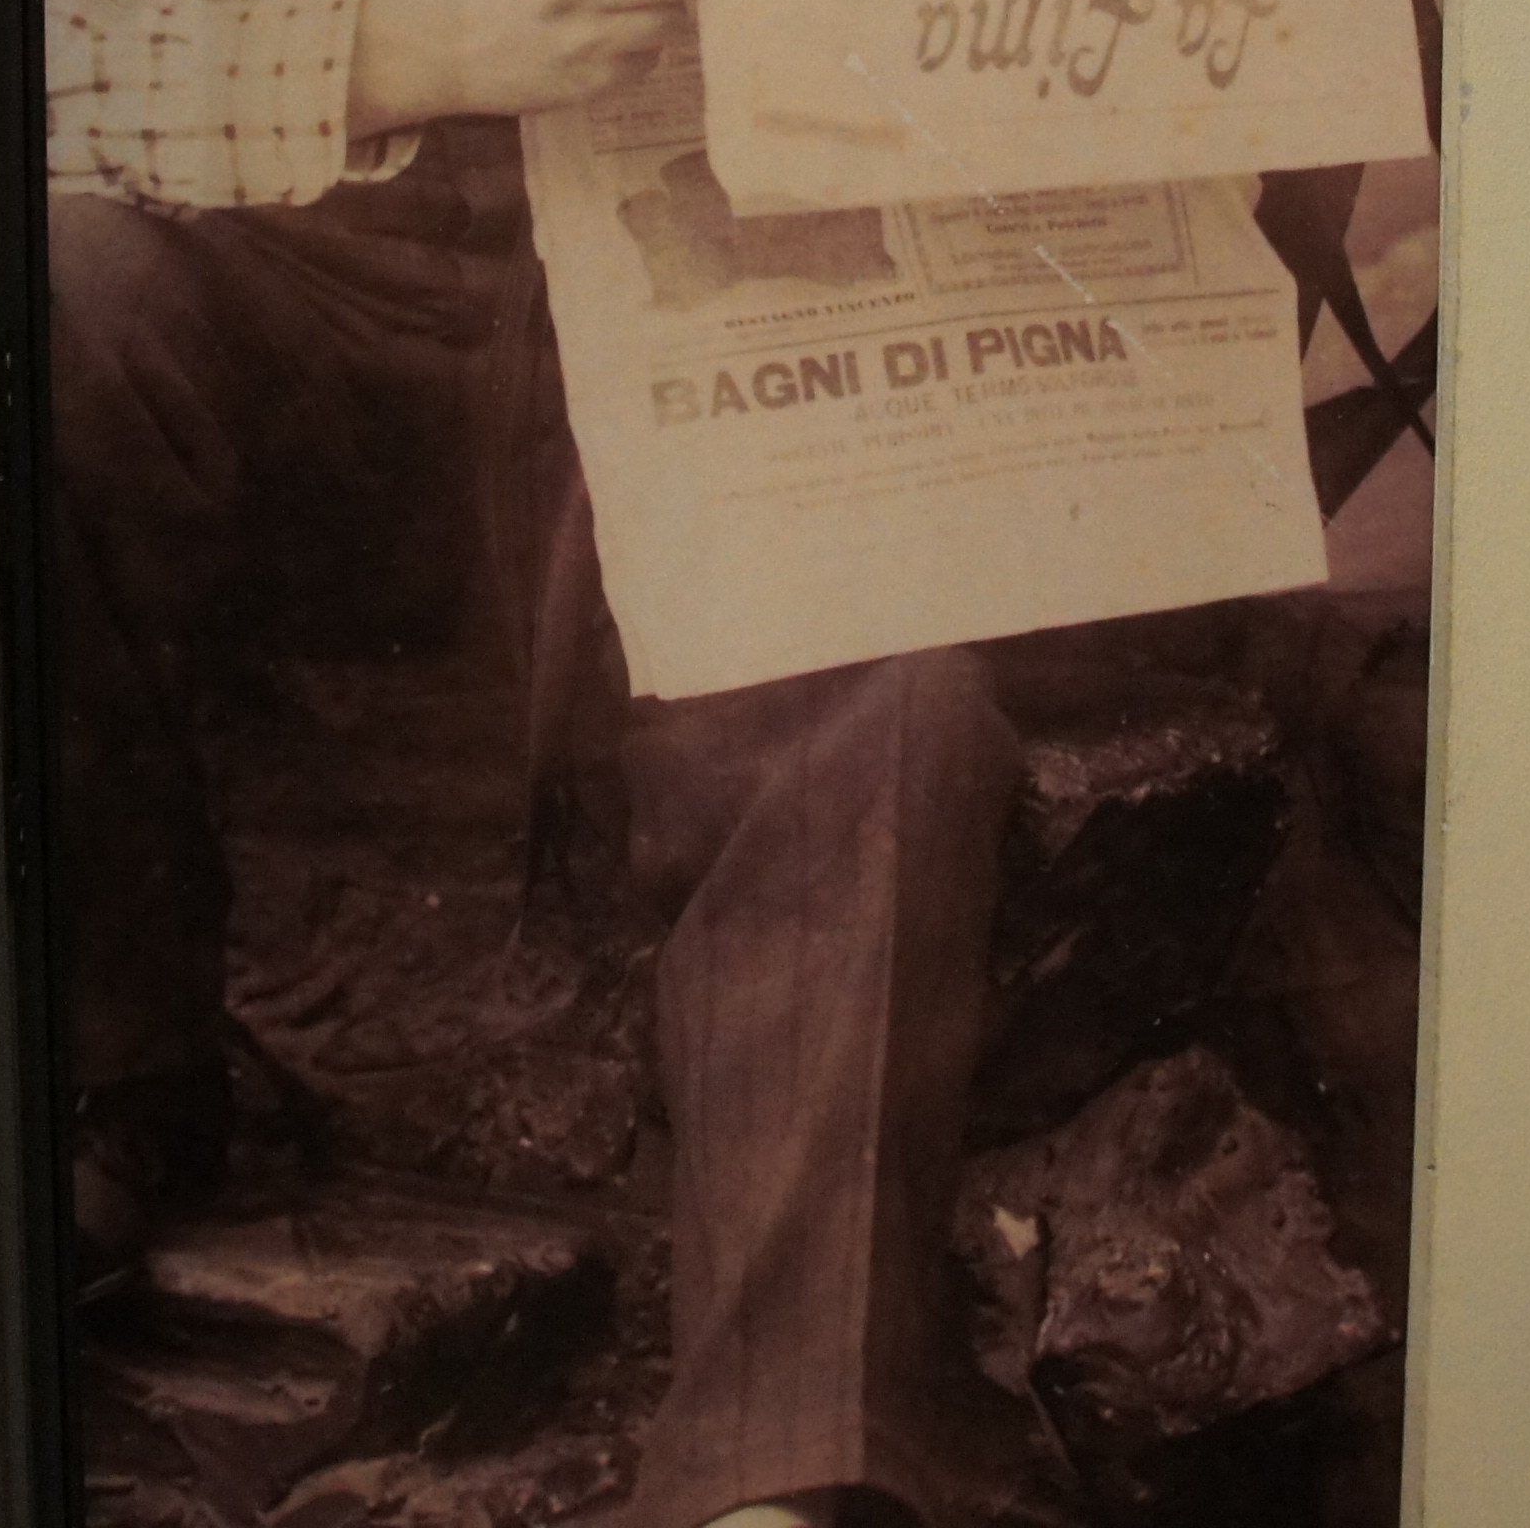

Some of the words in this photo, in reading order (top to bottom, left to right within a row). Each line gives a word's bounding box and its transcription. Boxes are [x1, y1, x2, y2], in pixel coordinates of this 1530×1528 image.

[650, 350, 862, 427] BAGNI
[882, 336, 950, 390] DI
[965, 316, 1128, 374] PIGNA
